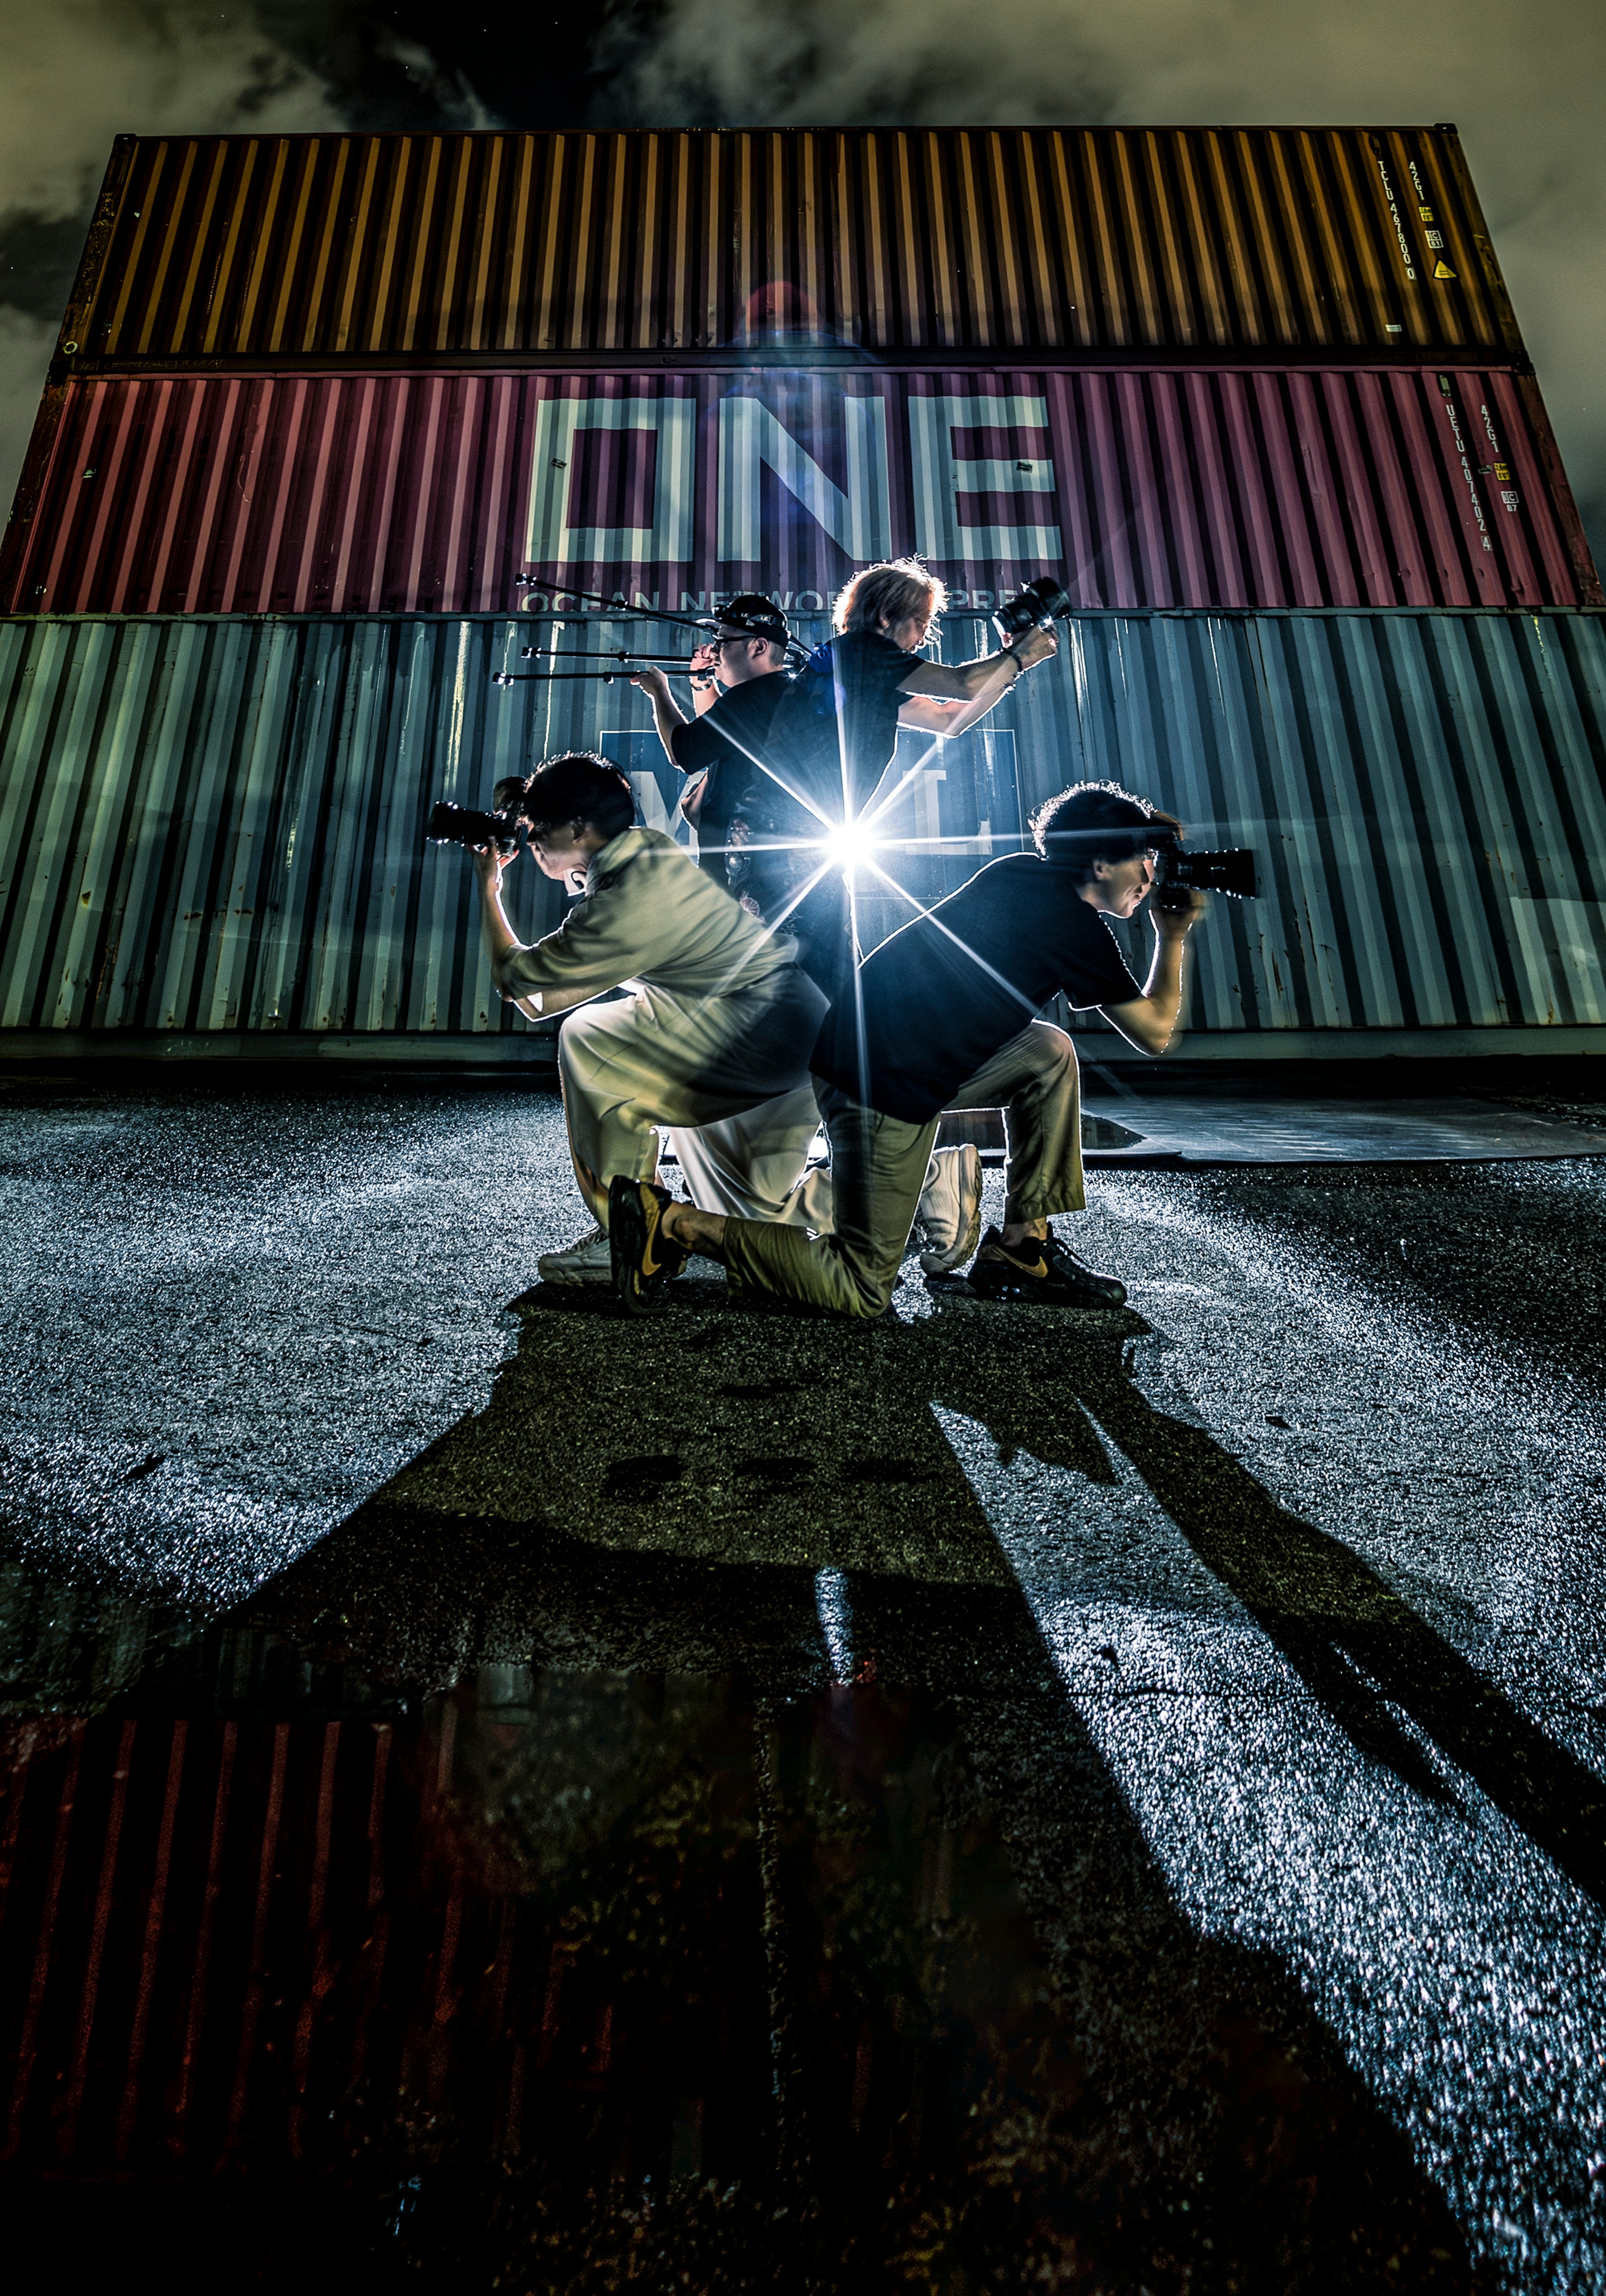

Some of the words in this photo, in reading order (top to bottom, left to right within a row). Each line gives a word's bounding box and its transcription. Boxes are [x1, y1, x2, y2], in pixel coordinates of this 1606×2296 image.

[1378, 161, 1394, 200] TCLU
[1390, 203, 1411, 264] 467800
[1409, 161, 1424, 200] 42G1
[1481, 404, 1499, 453] 42G1
[525, 396, 1063, 562] ONE
[1445, 404, 1465, 452] UETU
[1461, 456, 1486, 531] 407402
[522, 591, 659, 612] OCEAN
